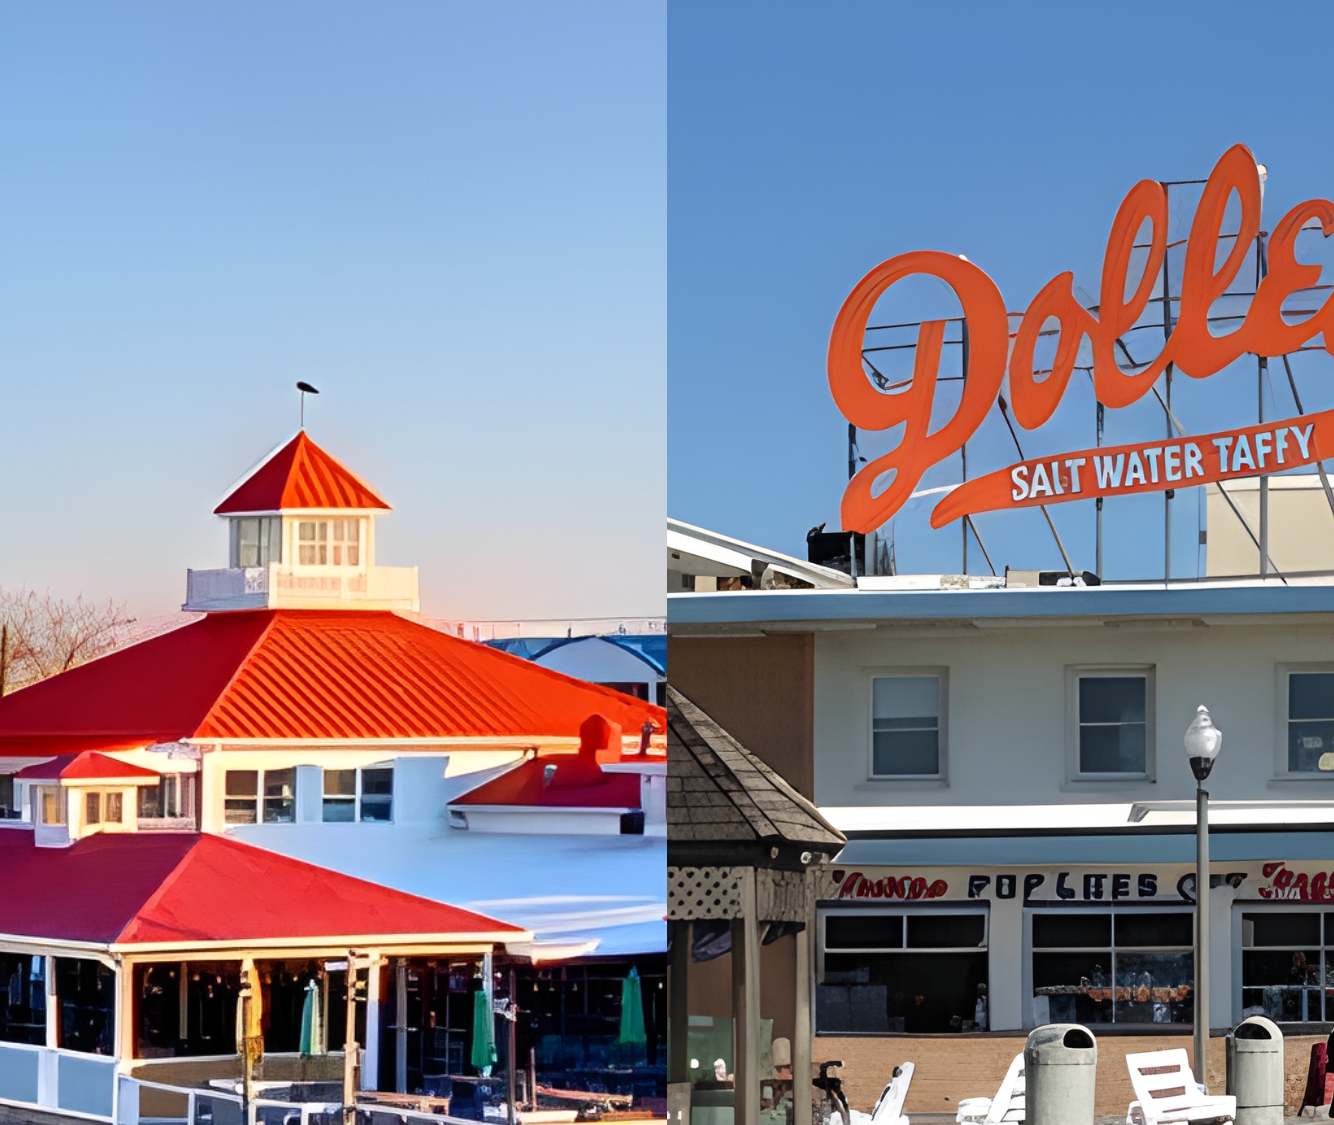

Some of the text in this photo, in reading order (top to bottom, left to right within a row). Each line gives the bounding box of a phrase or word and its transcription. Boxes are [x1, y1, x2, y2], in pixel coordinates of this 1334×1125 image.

[1011, 423, 1315, 501] SALT WATER TAFFY
